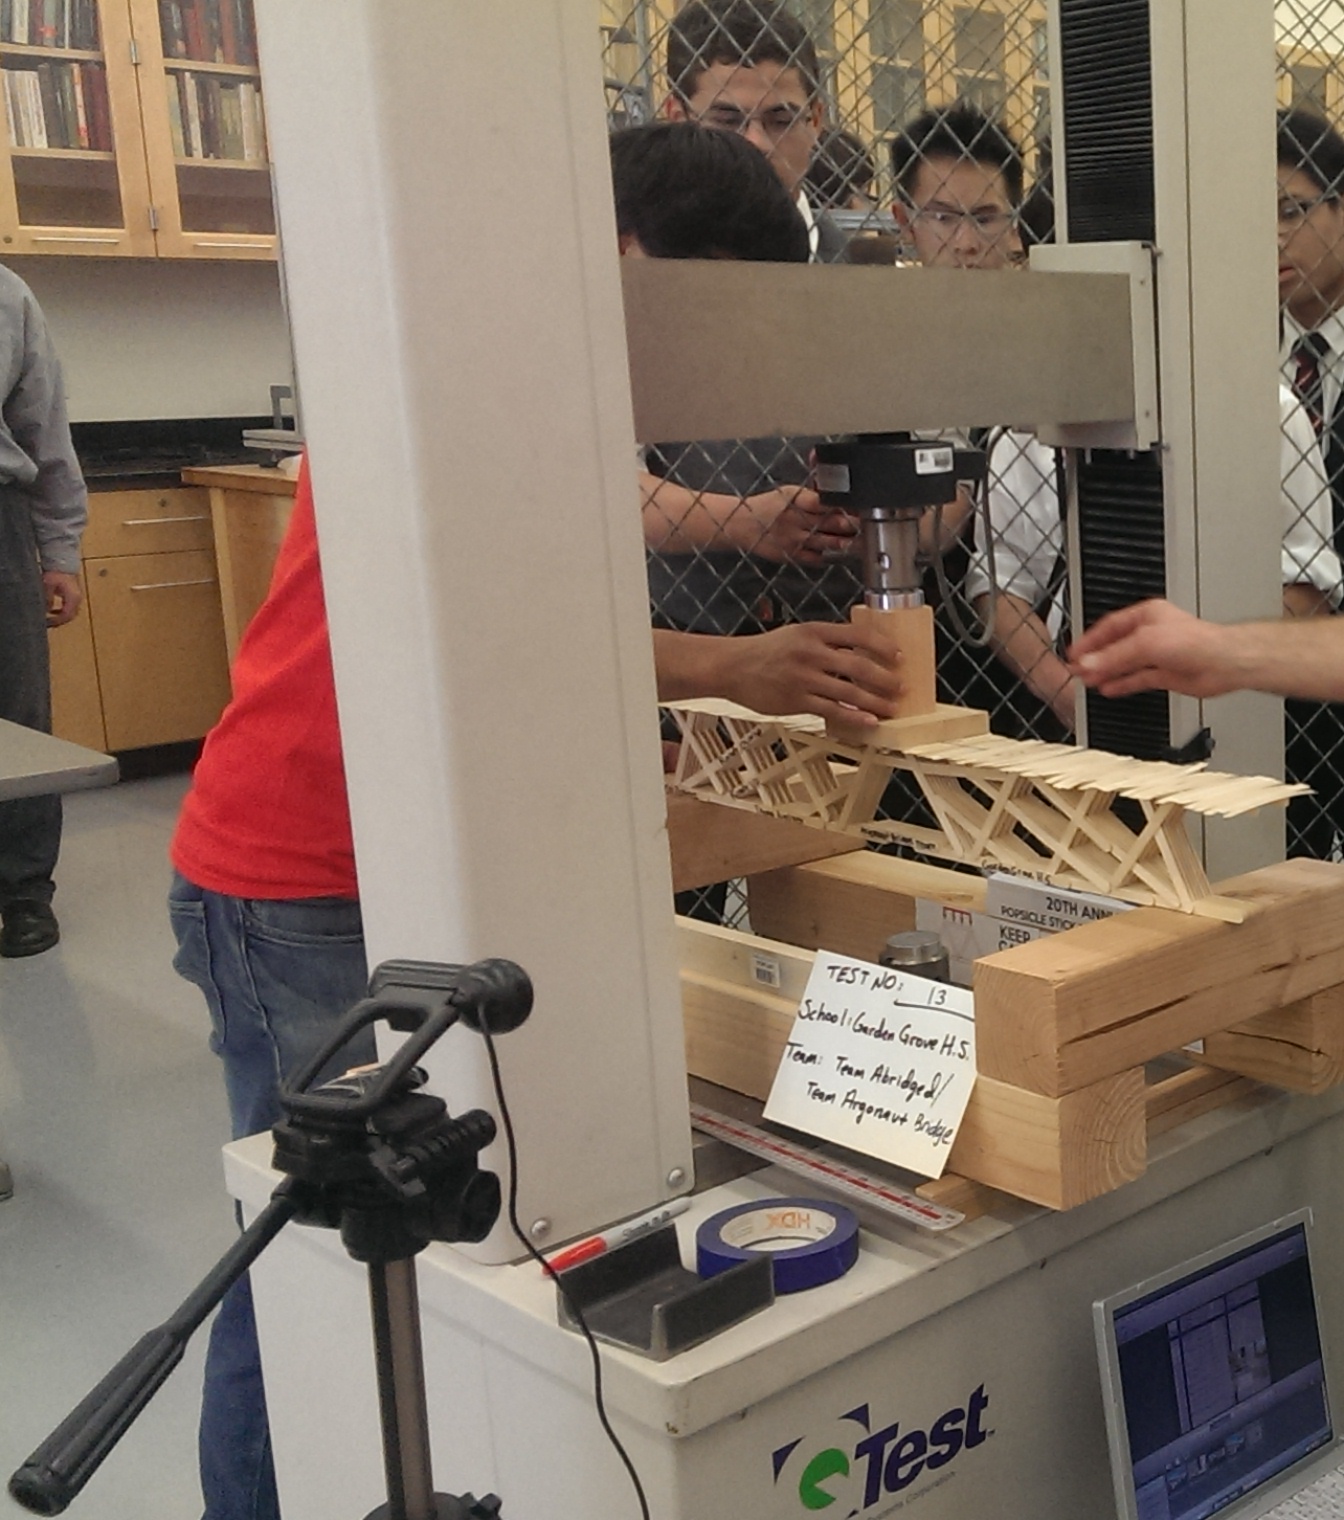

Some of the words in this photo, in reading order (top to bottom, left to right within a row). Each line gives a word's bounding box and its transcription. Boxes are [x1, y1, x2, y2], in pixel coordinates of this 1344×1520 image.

[1001, 905, 1047, 926] POPSICLE
[1046, 896, 1078, 916] 20TH
[827, 965, 870, 985] TEST
[927, 987, 947, 1005] 13
[852, 1011, 895, 1042] Garden
[899, 1024, 938, 1050] Grove
[786, 1041, 823, 1065] Team:
[836, 1056, 865, 1079] Team
[807, 1082, 836, 1104] Team
[841, 1089, 908, 1124] Argonaut
[914, 1113, 953, 1146] Bridge
